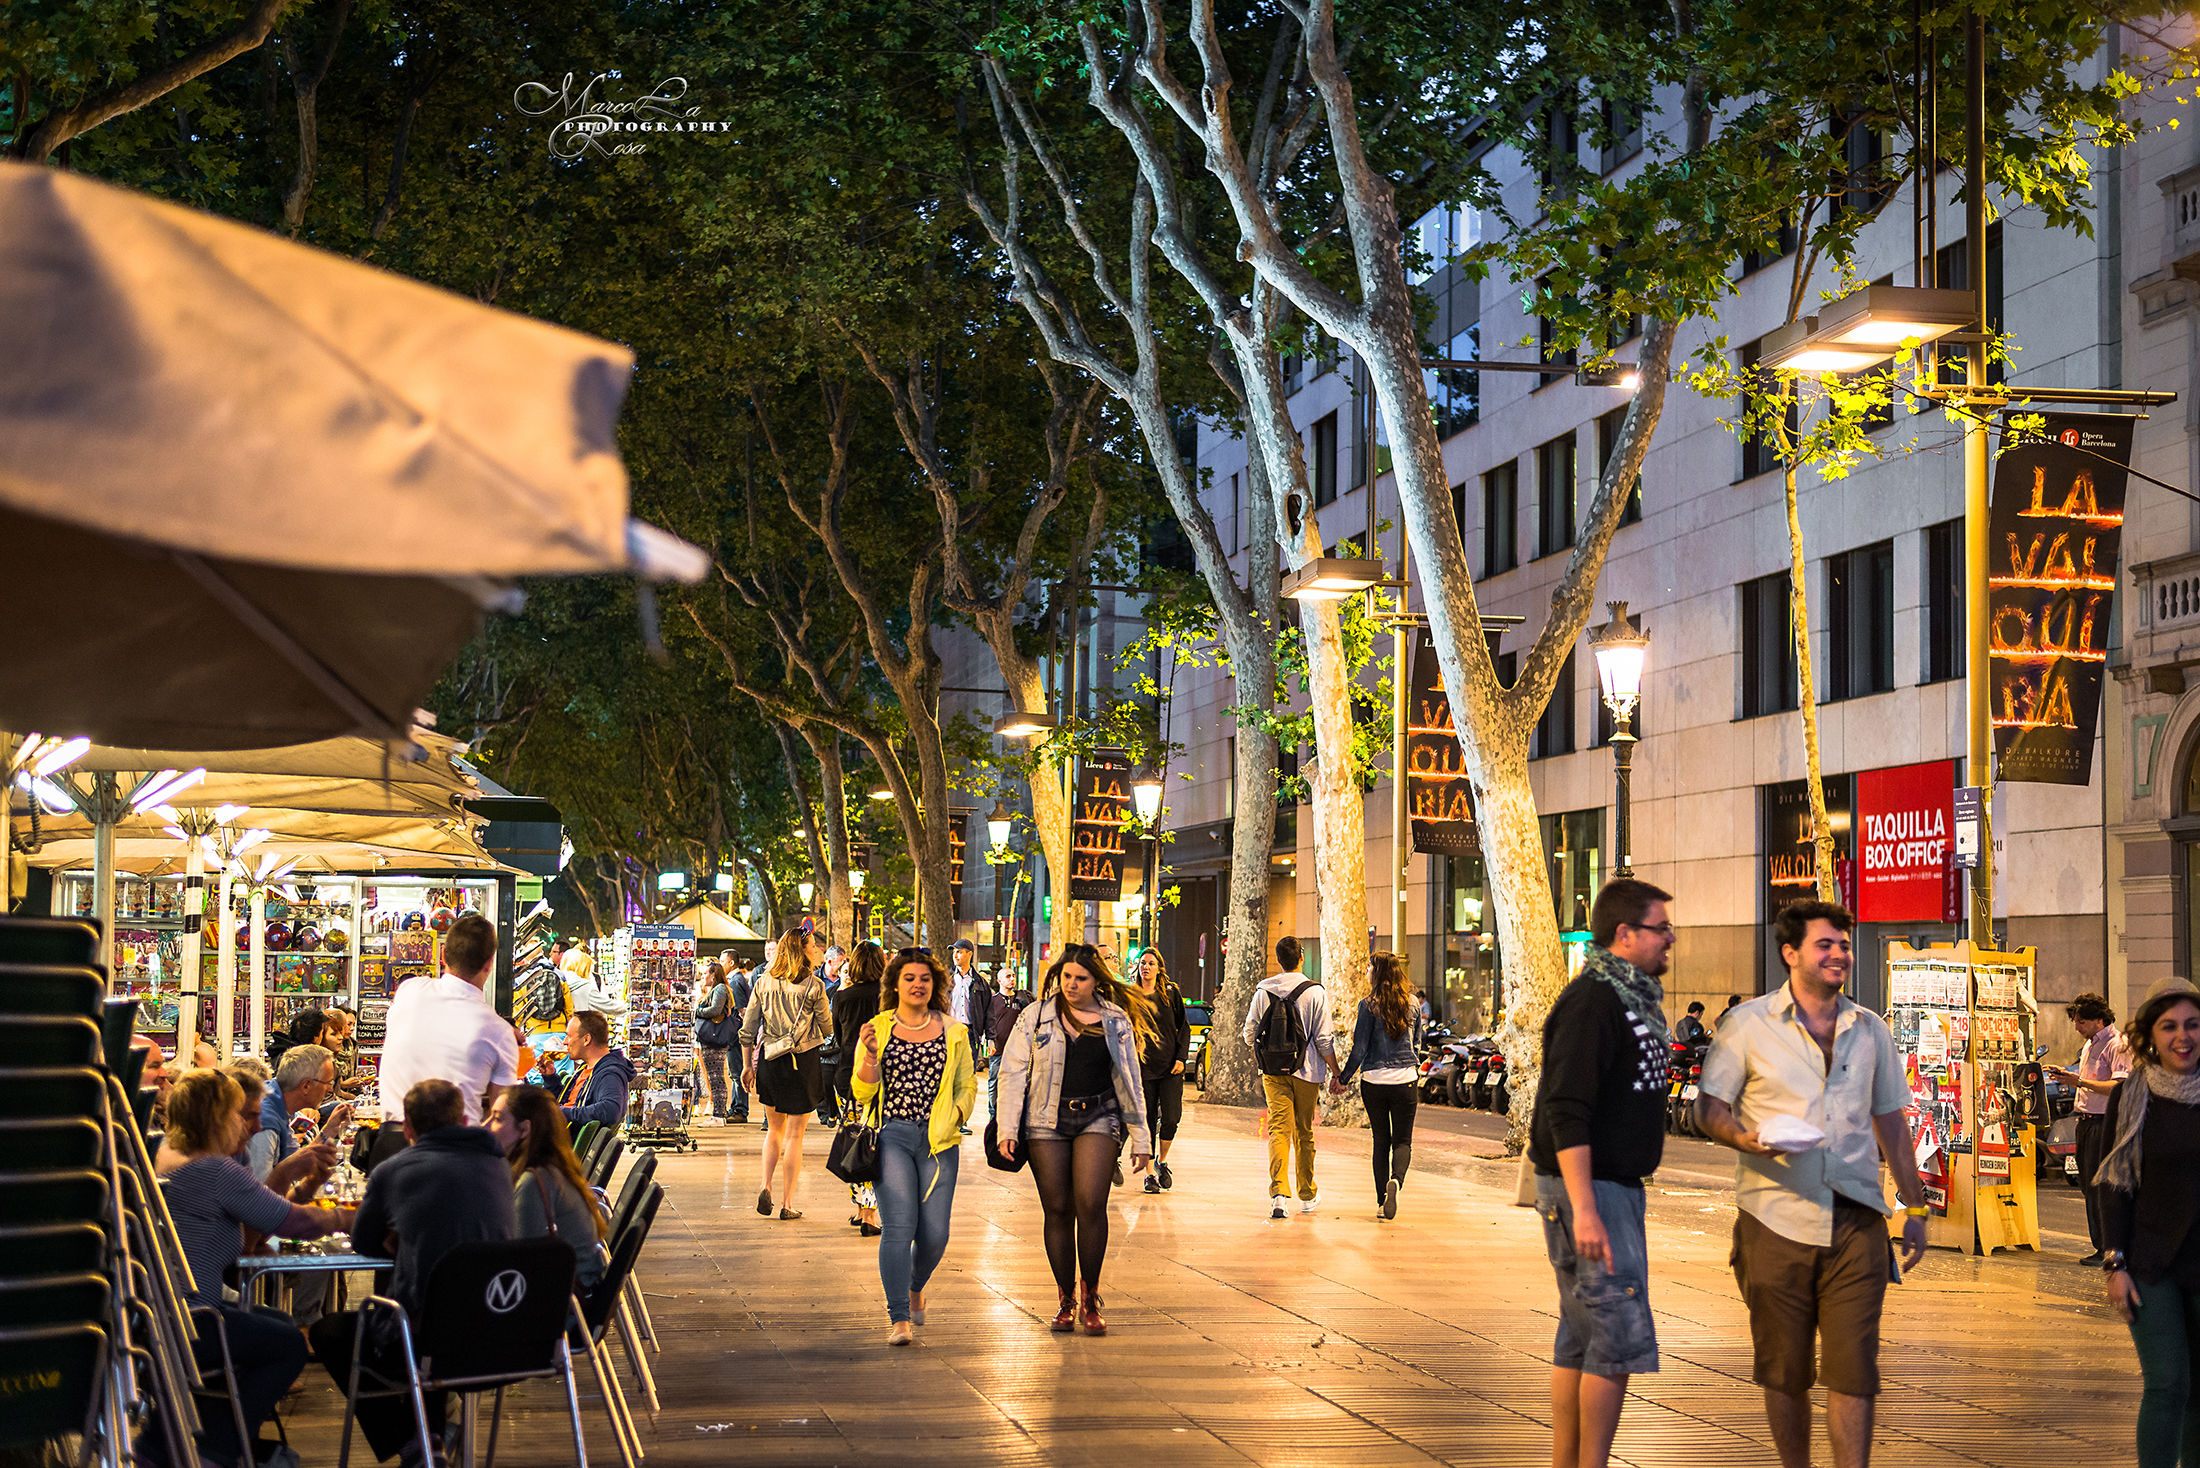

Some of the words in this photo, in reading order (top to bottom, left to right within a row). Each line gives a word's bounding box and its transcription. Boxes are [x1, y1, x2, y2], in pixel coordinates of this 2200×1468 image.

[2082, 431, 2103, 440] Opera
[2081, 440, 2116, 448] Barcelona
[2030, 466, 2099, 516] LA
[1094, 776, 1122, 796] LA
[1865, 808, 1946, 842] TAQUILLA
[1865, 844, 1895, 870] BOX
[1896, 838, 1946, 868] OFFICE
[1957, 1017, 1968, 1031] 18
[1980, 1017, 1988, 1031] 18
[1993, 1018, 2003, 1032] 18
[2008, 1018, 2019, 1033] 18
